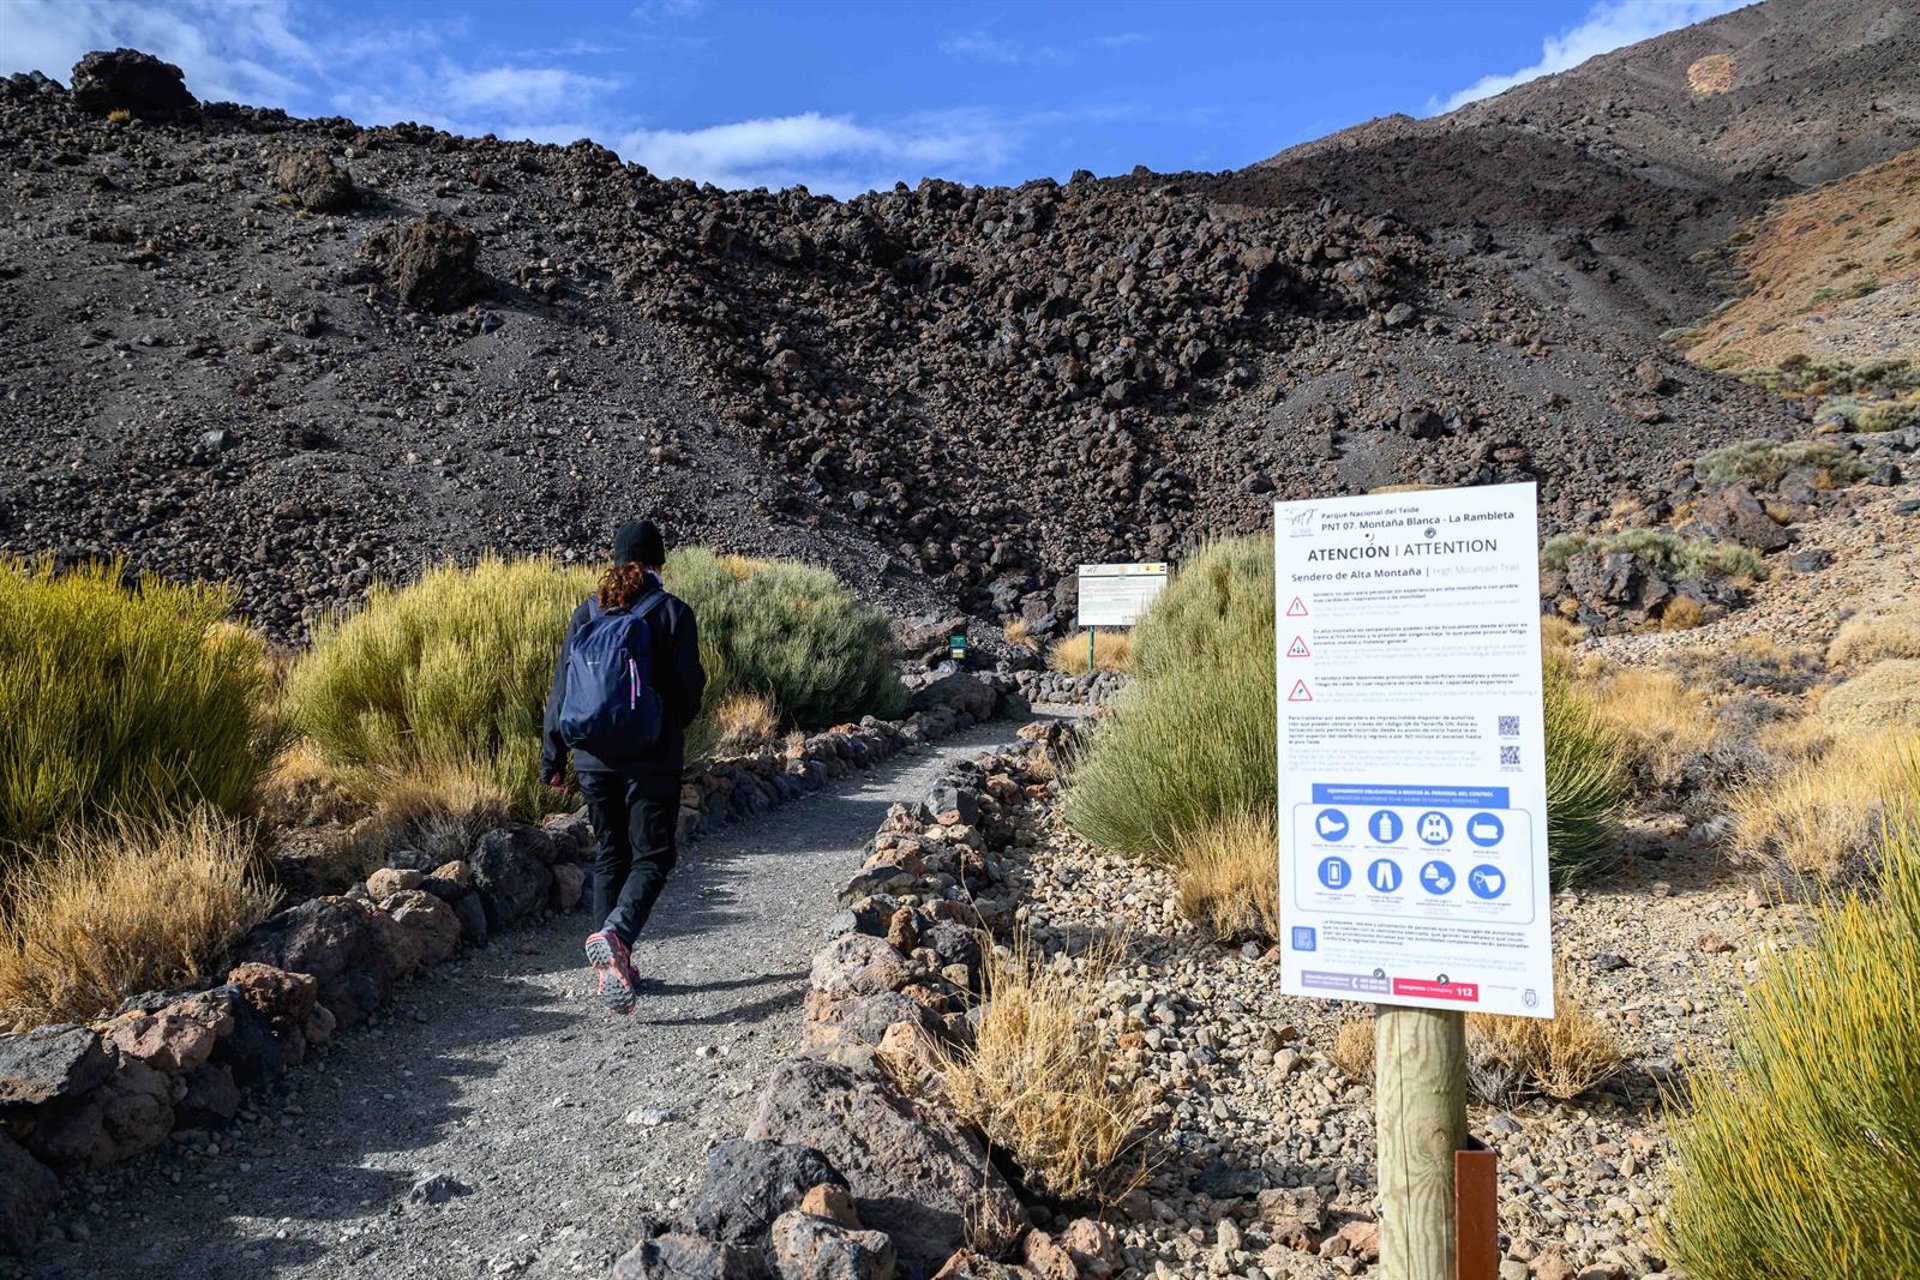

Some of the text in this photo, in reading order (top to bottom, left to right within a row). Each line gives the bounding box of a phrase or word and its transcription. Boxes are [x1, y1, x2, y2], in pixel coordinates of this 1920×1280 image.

[1321, 506, 1420, 522] Parque Nacional del Teide
[1321, 522, 1341, 531] PNT
[1342, 521, 1358, 530] 07.
[1359, 517, 1404, 529] Montaña
[1406, 516, 1441, 526] Blanca
[1449, 514, 1461, 523] La
[1463, 511, 1515, 522] Rambleta
[1307, 541, 1390, 562] ATENCIÓN
[1403, 538, 1498, 556] ATTENTION
[1291, 572, 1333, 582] Sendero
[1335, 571, 1348, 580] de
[1350, 570, 1371, 579] Alta
[1373, 566, 1423, 578] Montaña
[1457, 986, 1473, 997] 112
